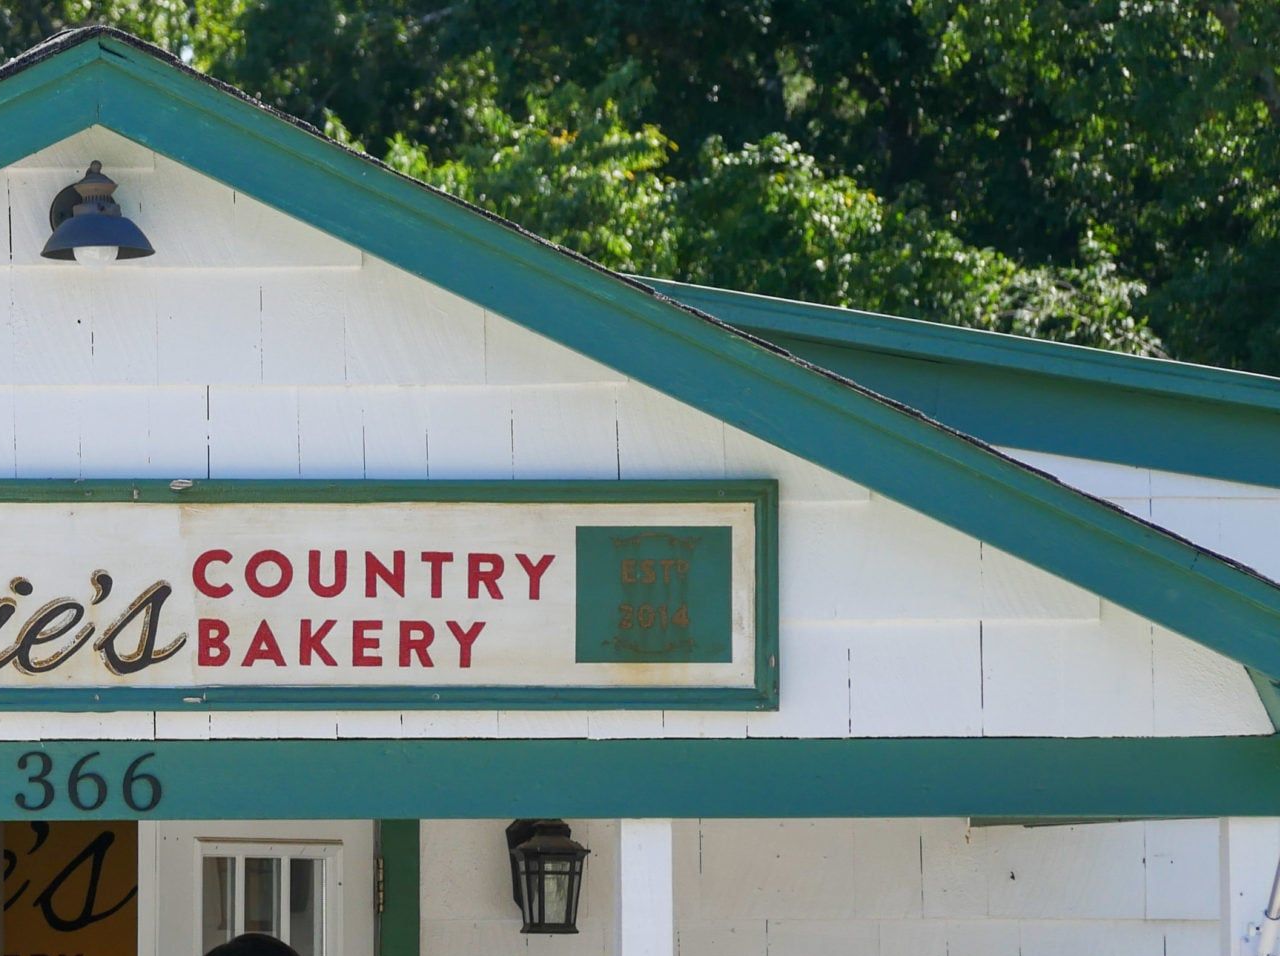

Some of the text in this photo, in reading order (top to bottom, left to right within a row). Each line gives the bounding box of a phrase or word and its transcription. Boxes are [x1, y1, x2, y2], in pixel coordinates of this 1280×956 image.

[192, 548, 556, 600] COUNTRY
[618, 604, 690, 630] 2014
[197, 618, 487, 668] BAKERY
[15, 751, 162, 812] 366
